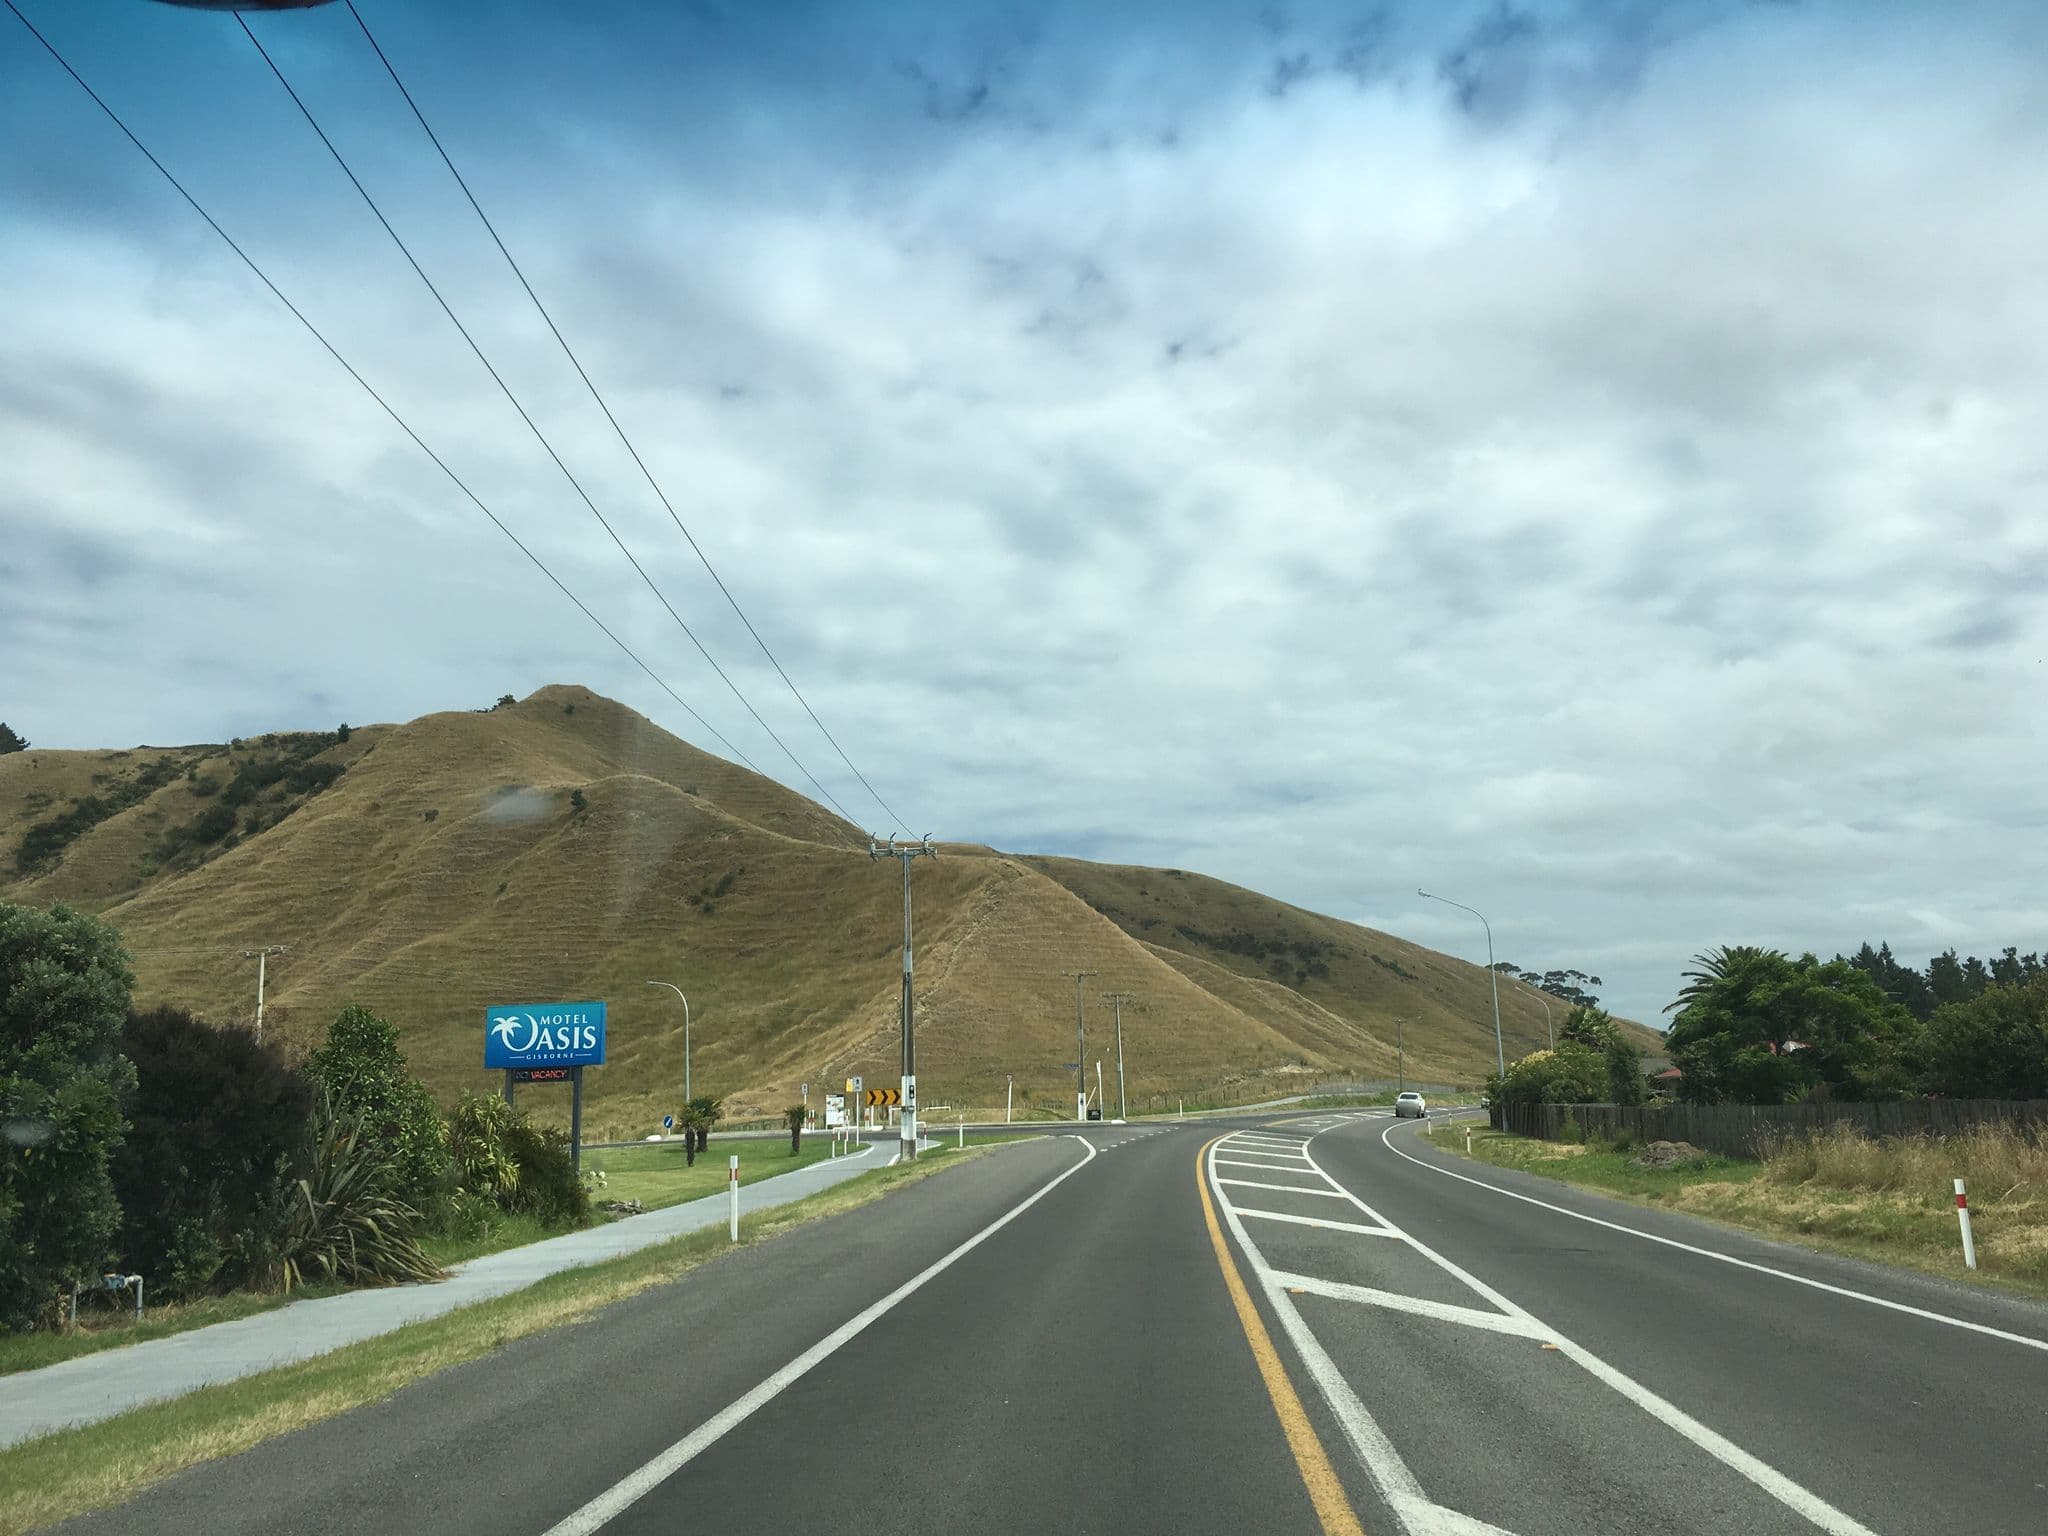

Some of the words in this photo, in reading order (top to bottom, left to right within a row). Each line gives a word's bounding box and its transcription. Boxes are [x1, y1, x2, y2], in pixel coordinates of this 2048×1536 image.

[540, 1014, 588, 1025] MOTEL
[498, 1013, 597, 1052] OASIS
[530, 1069, 567, 1079] VACANCY
